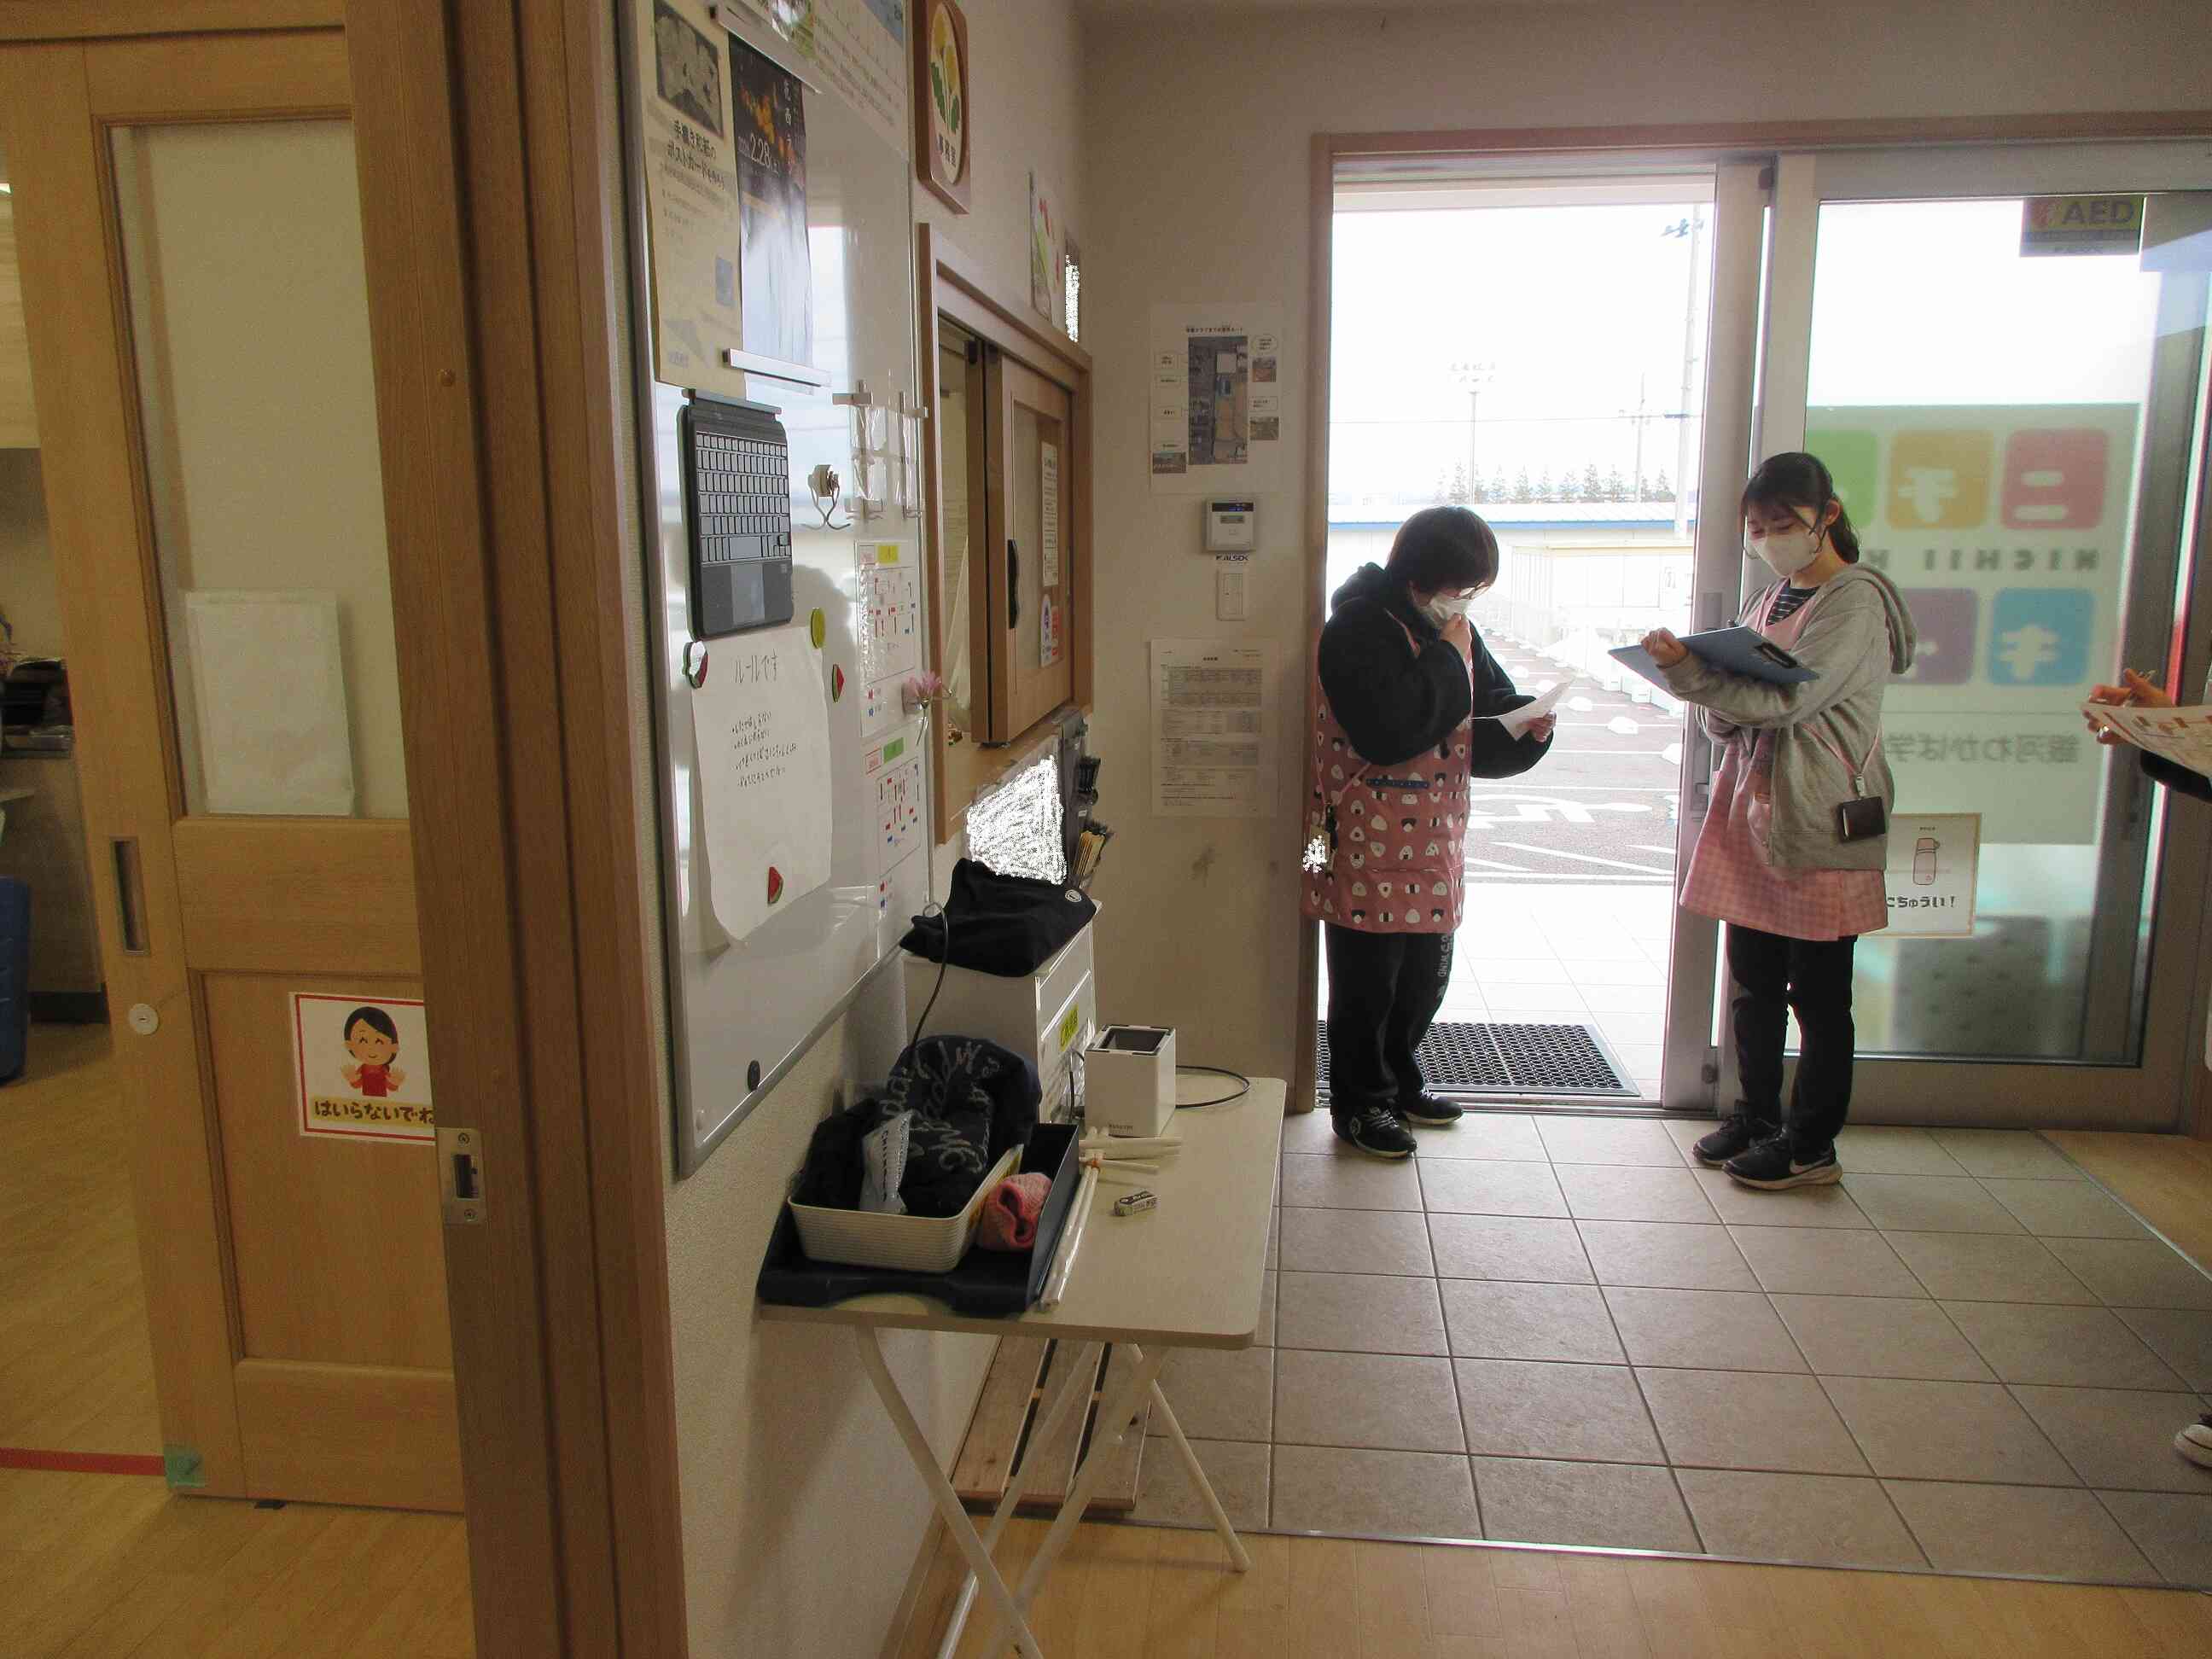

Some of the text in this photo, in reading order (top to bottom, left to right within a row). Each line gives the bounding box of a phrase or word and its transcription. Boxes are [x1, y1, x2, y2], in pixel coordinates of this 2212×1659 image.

[2062, 201, 2134, 224] AED
[314, 1099, 436, 1125] はいらないでね
